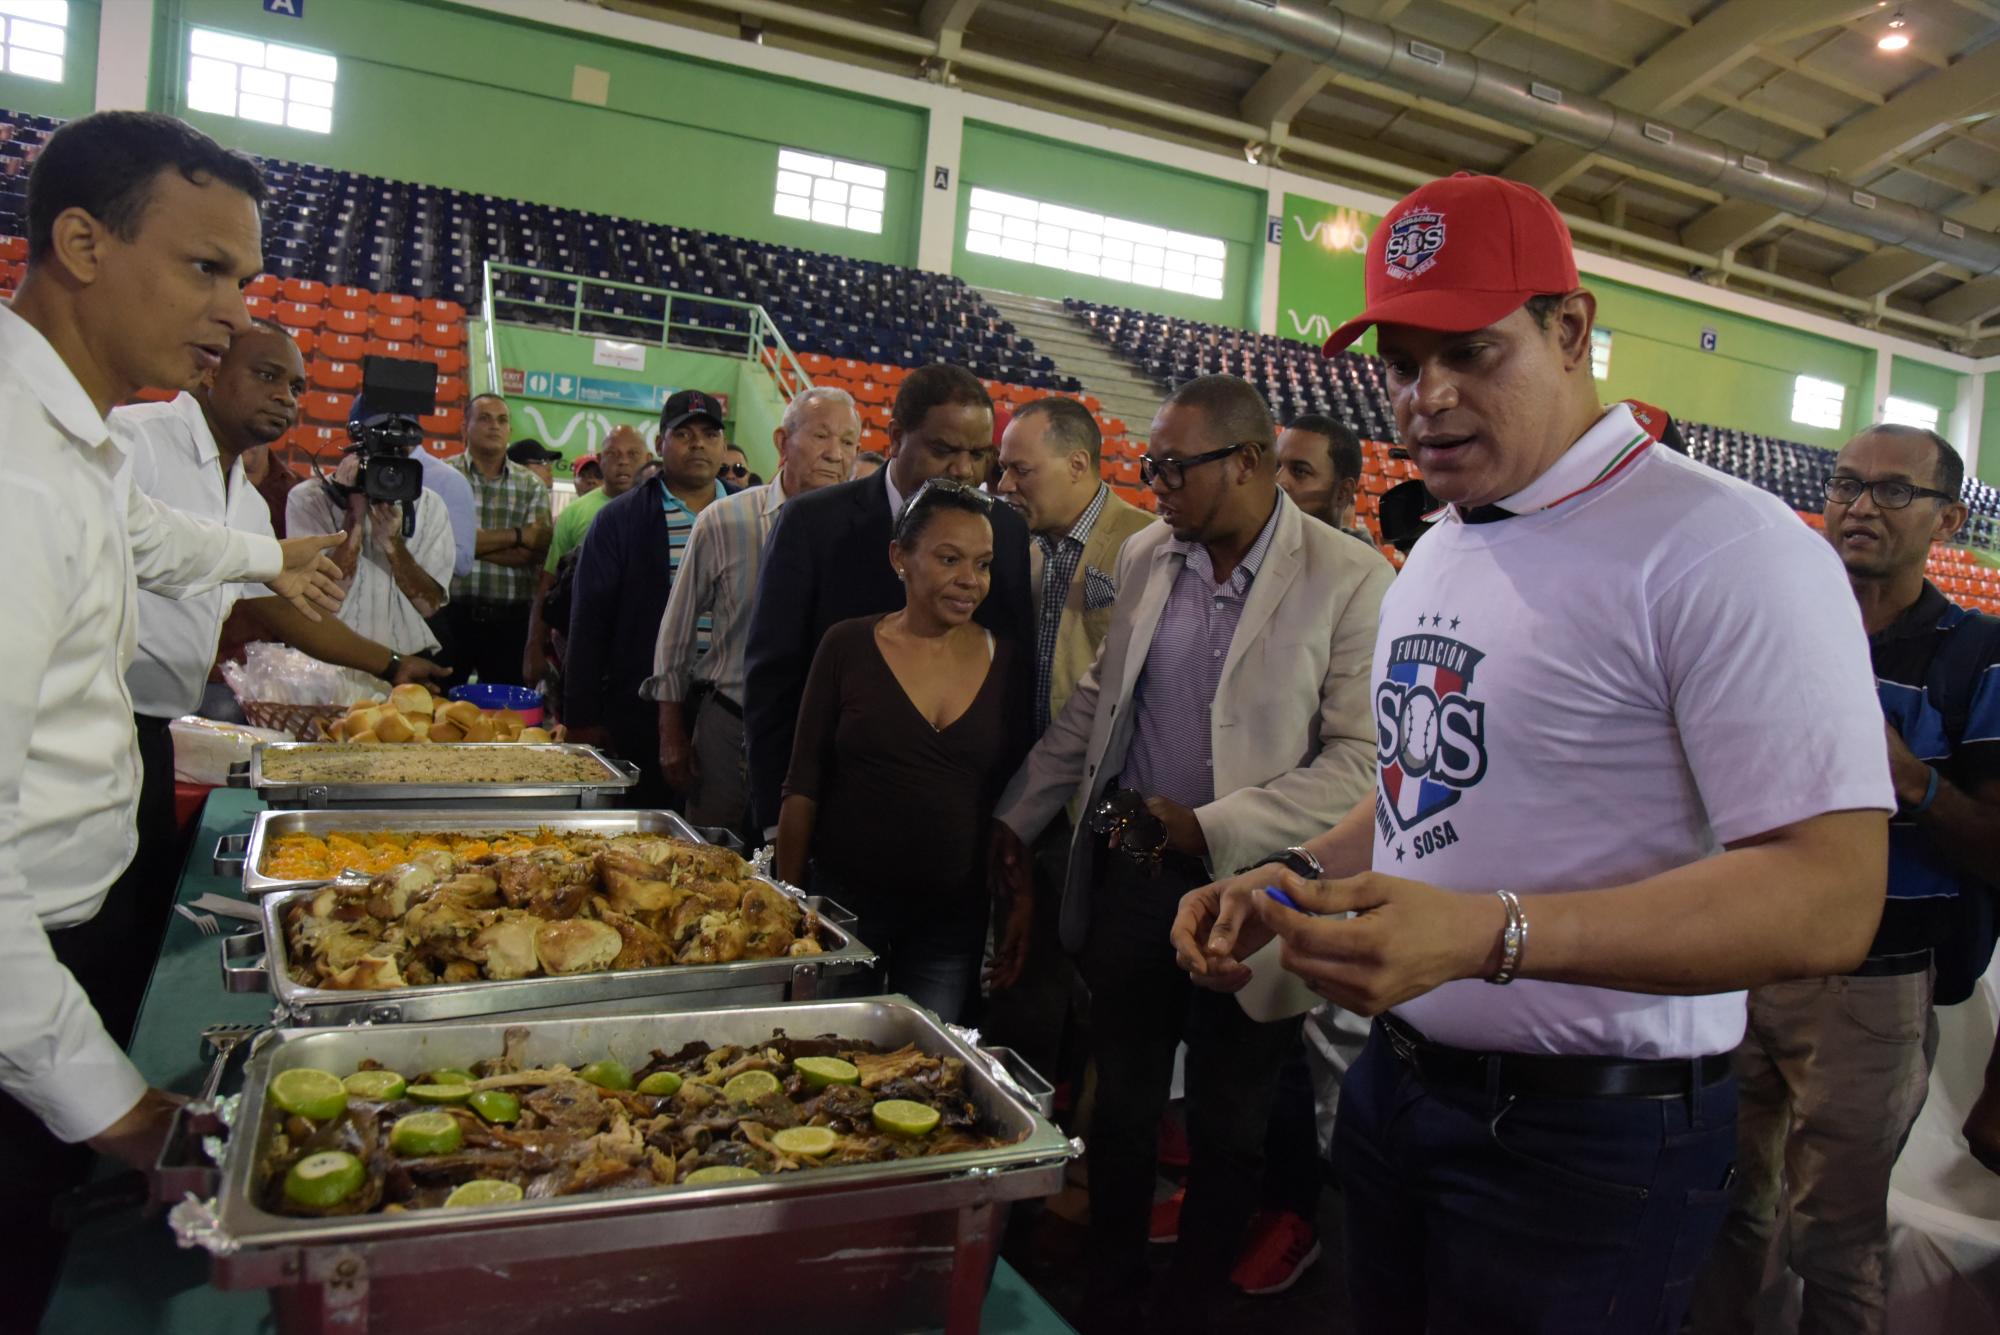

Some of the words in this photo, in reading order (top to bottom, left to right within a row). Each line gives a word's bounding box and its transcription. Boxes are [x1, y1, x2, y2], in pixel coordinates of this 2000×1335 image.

[936, 172, 947, 188] A
[1387, 226, 1444, 261] SOS
[1703, 334, 1714, 349] C
[1396, 640, 1468, 672] FUNDACIÓN
[1377, 682, 1488, 788] SOS
[1376, 785, 1396, 848] AMMY
[1413, 820, 1459, 860] SOSA
